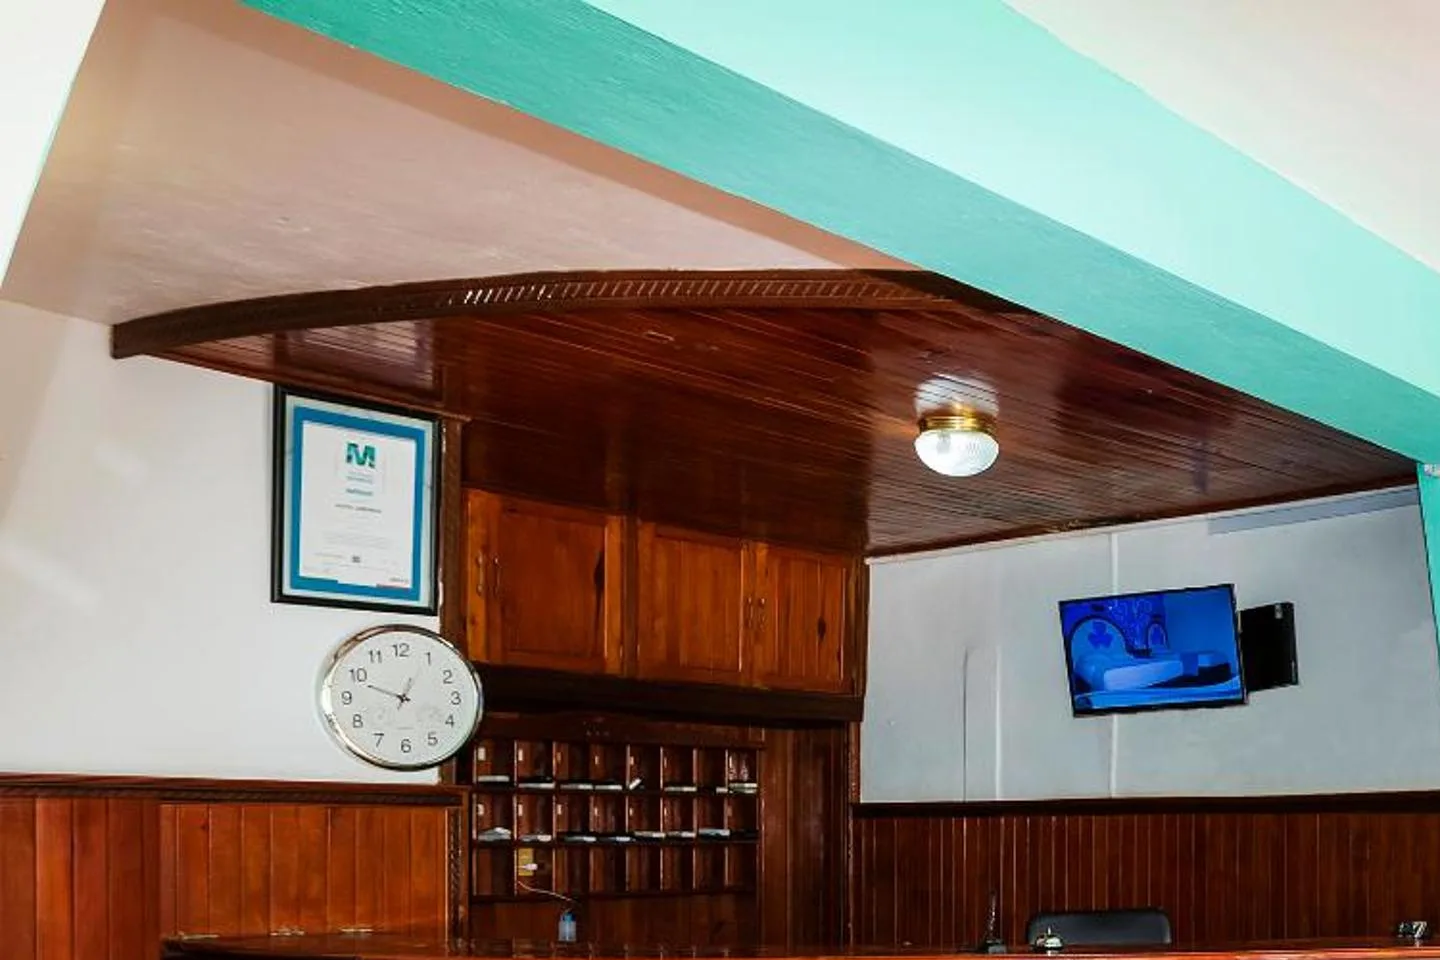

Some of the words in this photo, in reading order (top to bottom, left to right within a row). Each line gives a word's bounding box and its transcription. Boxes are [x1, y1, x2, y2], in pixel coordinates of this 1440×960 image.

[368, 649, 382, 664] 11
[391, 642, 410, 658] 12
[349, 667, 368, 683] 10
[442, 670, 453, 685] 2
[341, 690, 353, 705] 9
[450, 691, 462, 706] 3
[352, 713, 364, 728] 8
[444, 715, 455, 728] 4
[373, 732, 385, 748] 7
[400, 738, 412, 754] 6
[427, 732, 439, 746] 5
